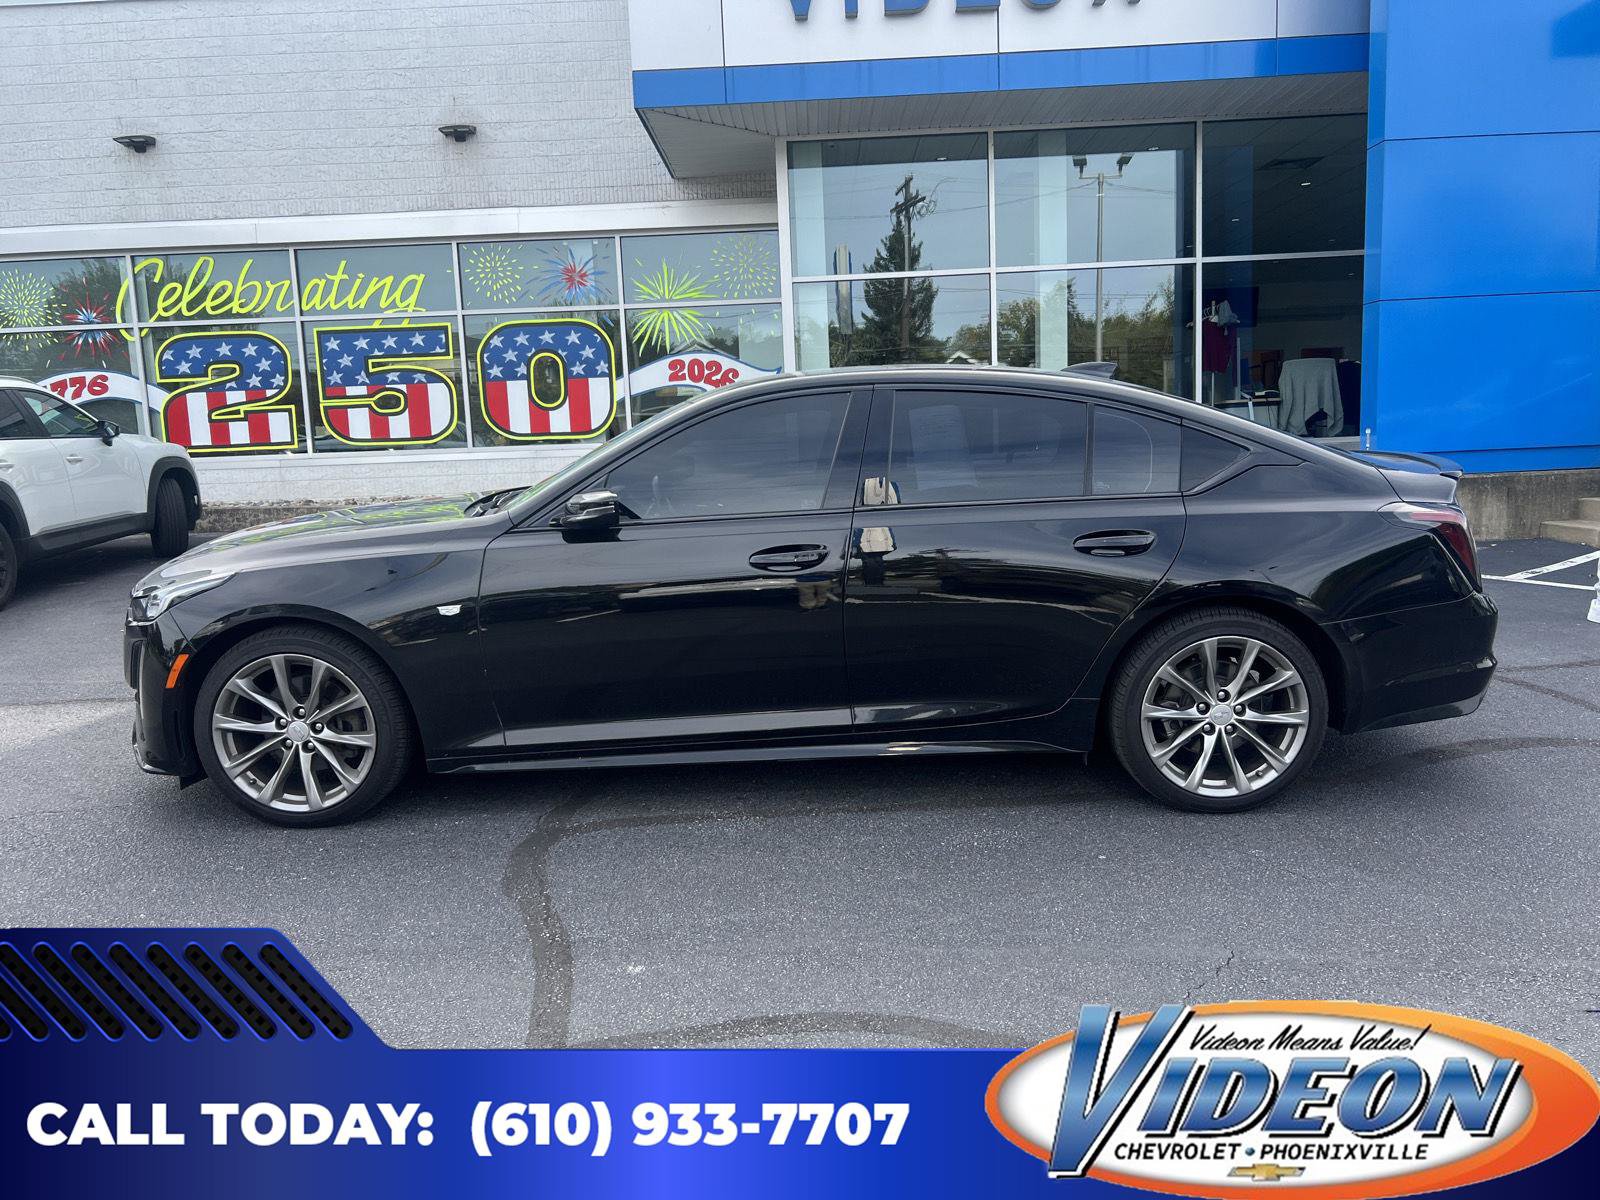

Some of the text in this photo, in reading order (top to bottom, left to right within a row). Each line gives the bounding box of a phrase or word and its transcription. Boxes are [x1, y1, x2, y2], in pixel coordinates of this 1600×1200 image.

[115, 256, 427, 342] Celebrating
[41, 374, 110, 401] 776
[155, 318, 617, 453] 250
